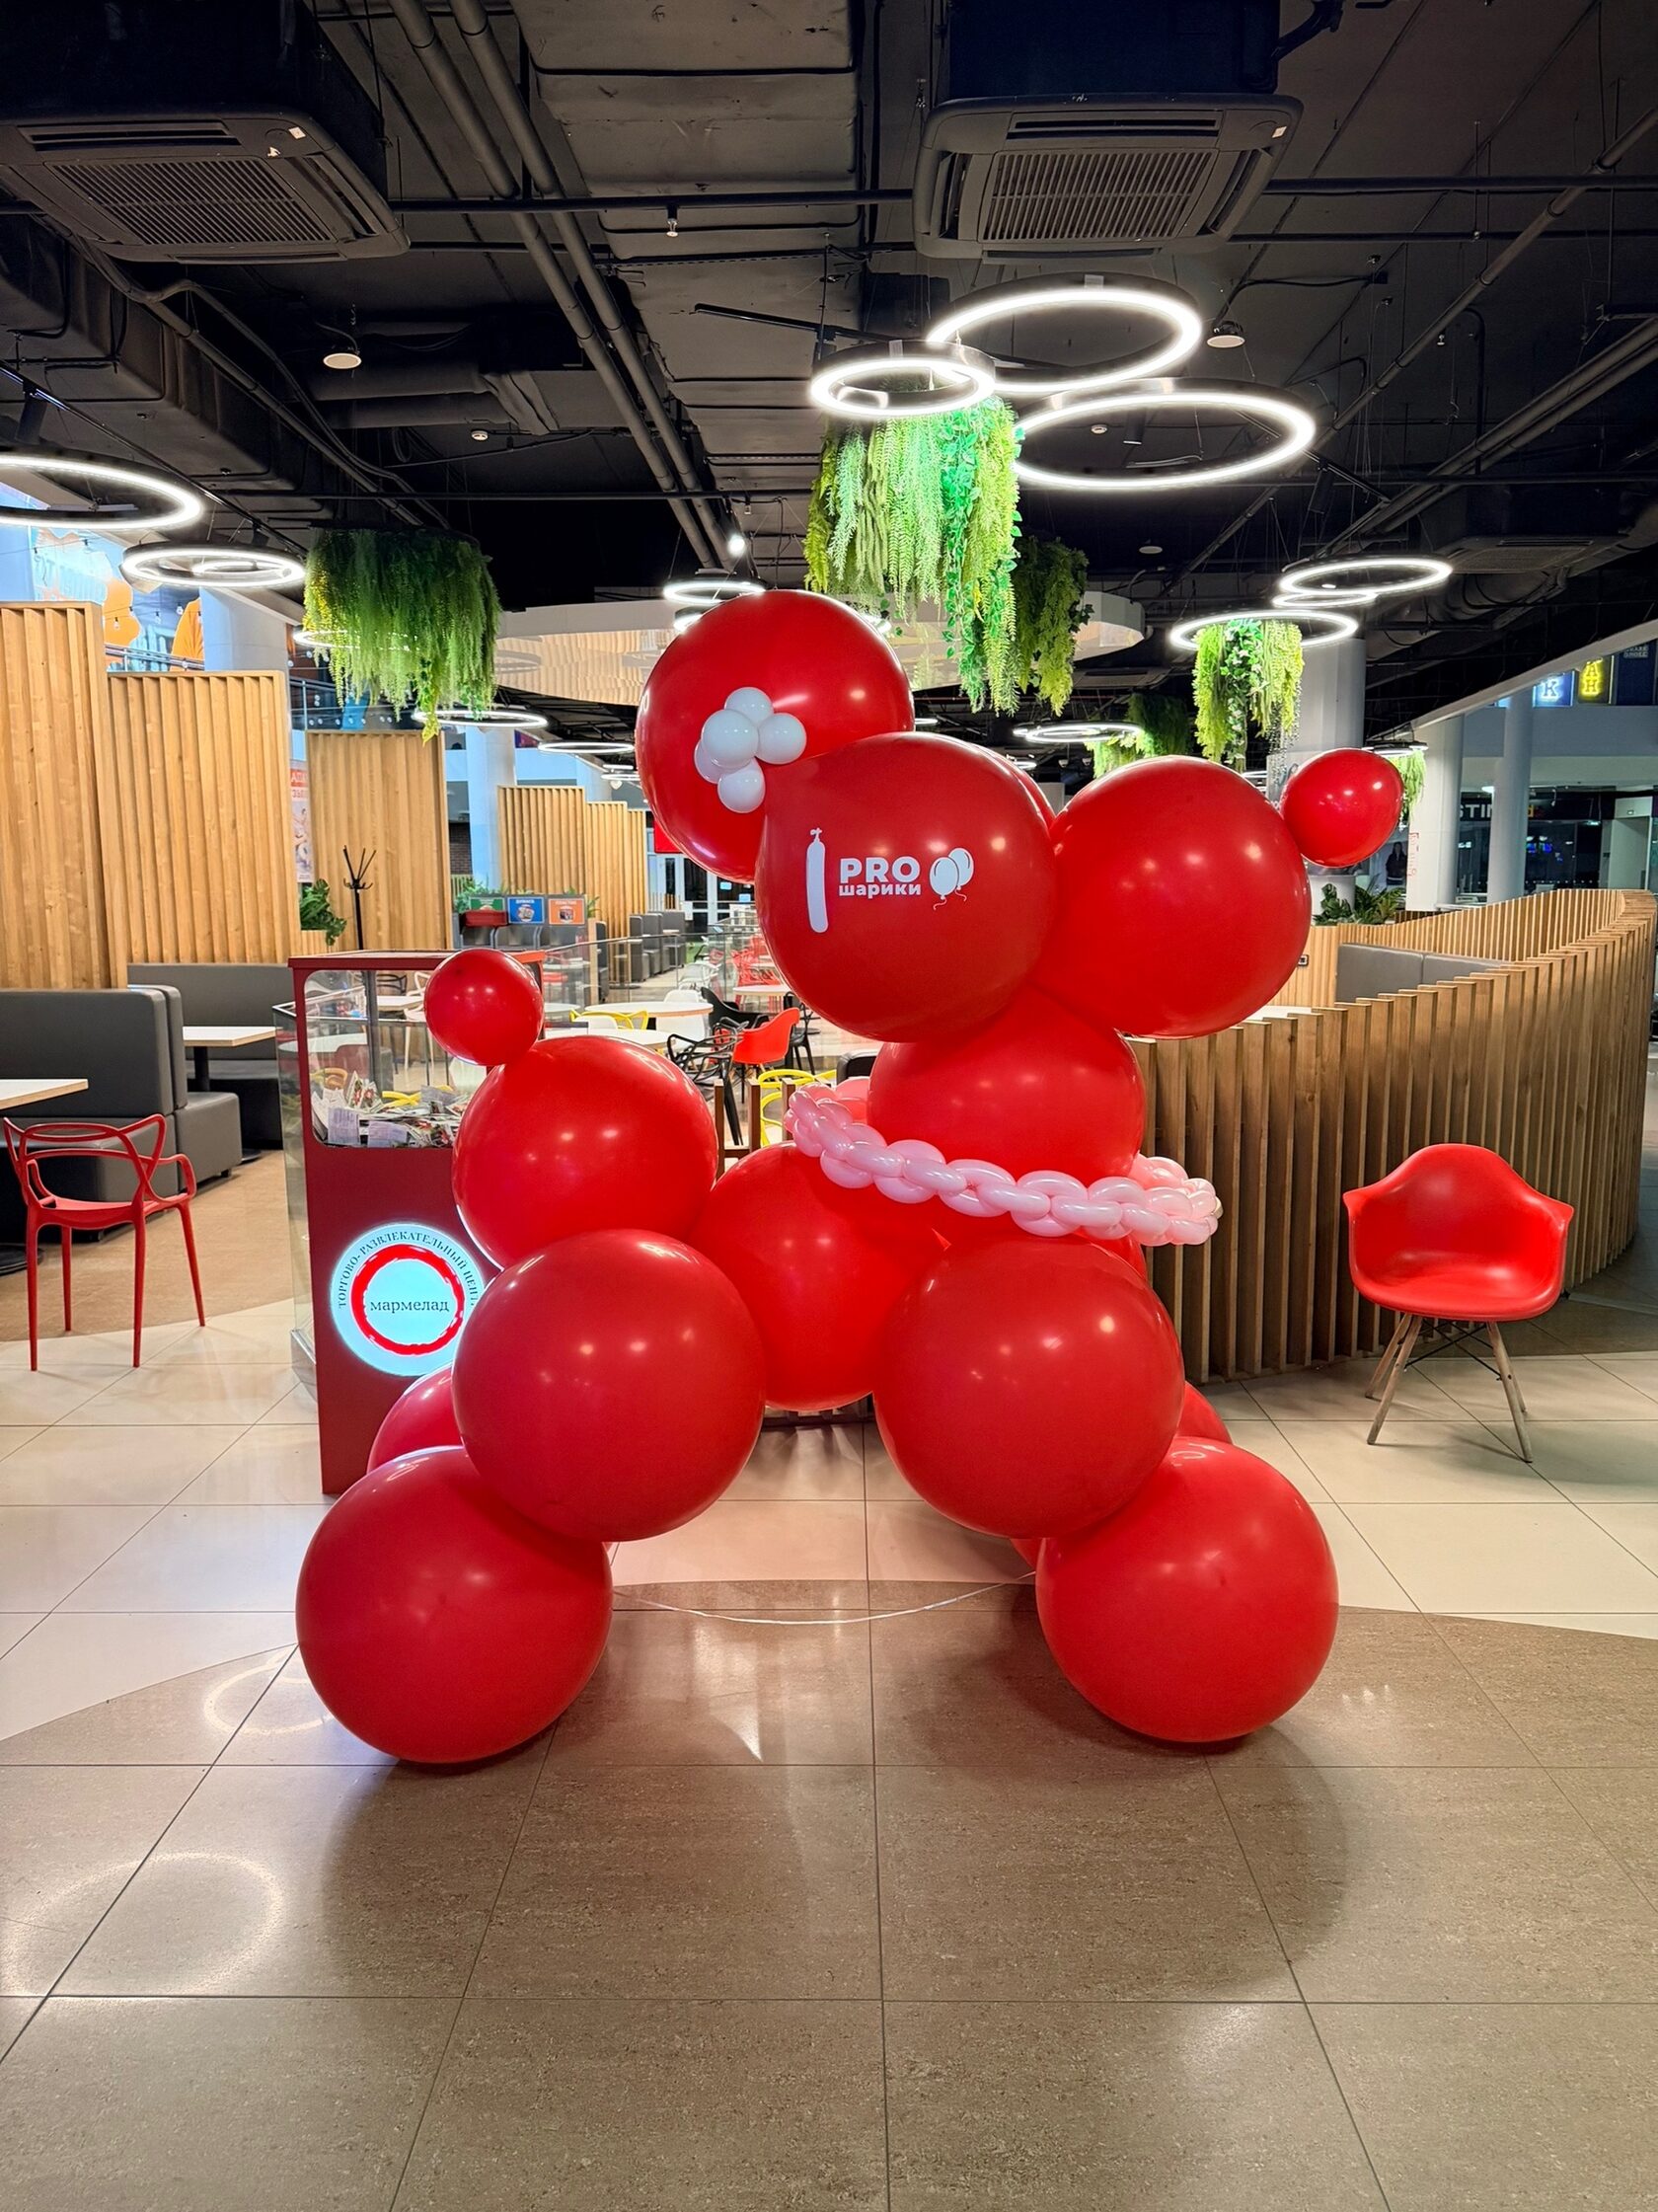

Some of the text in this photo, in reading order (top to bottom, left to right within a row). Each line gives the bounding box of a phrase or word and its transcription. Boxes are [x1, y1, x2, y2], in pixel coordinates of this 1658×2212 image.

[840, 856, 921, 883] PRO
[839, 883, 921, 899] шарики
[370, 1300, 450, 1314] мармелад
